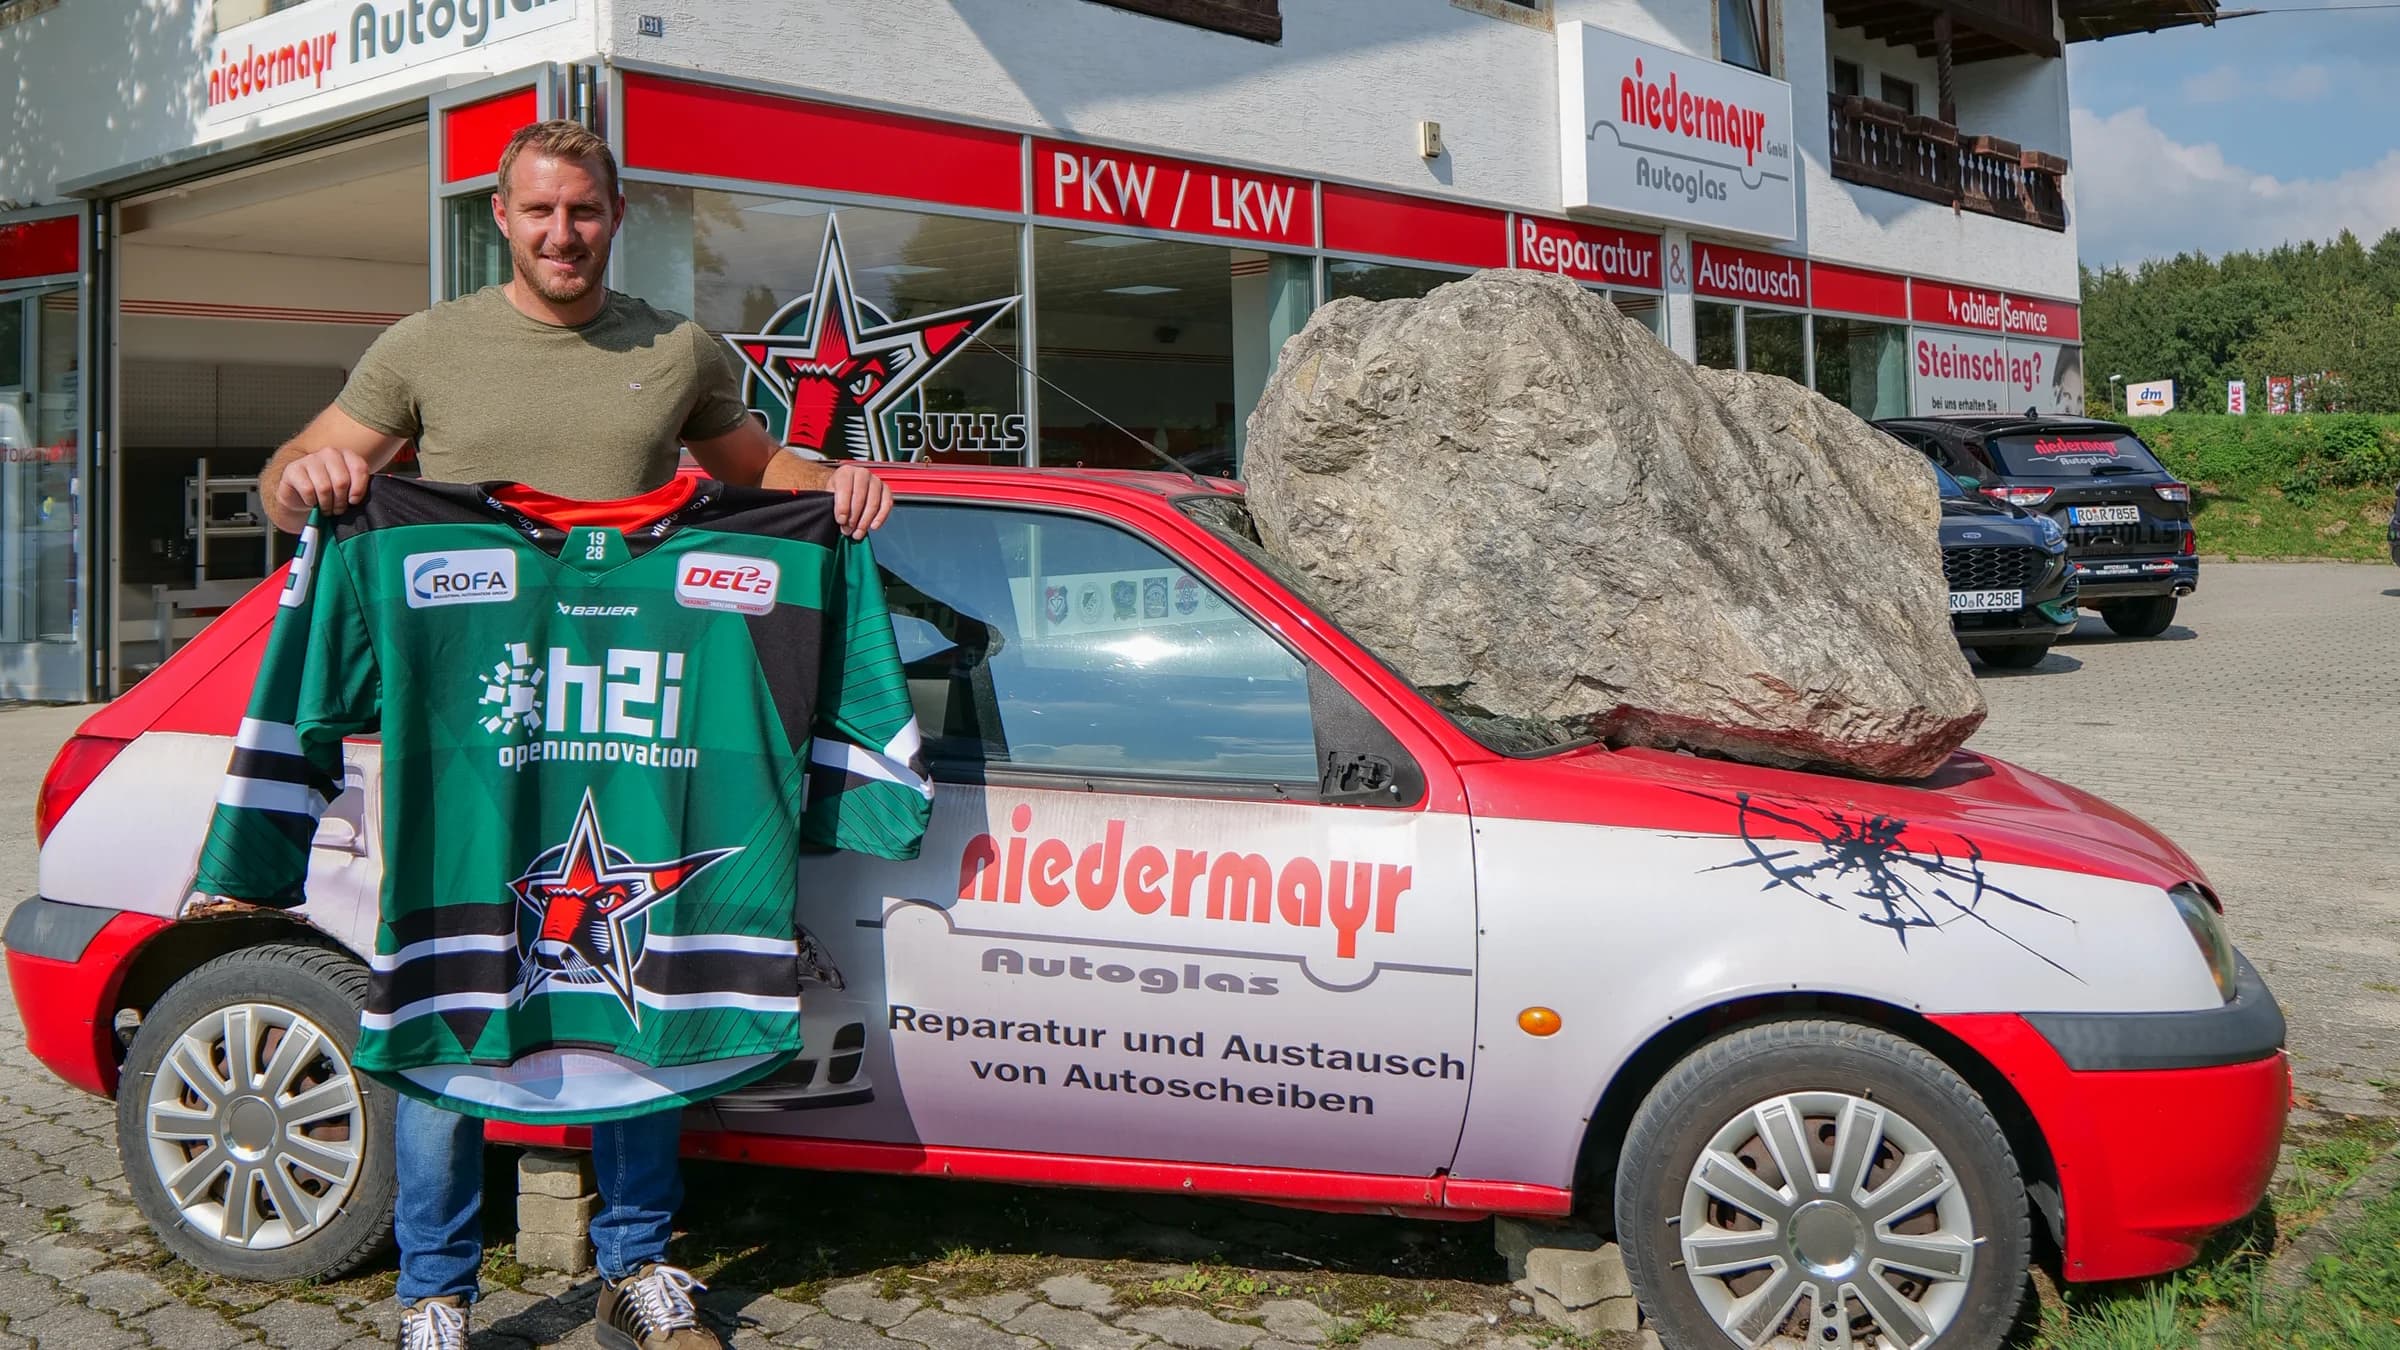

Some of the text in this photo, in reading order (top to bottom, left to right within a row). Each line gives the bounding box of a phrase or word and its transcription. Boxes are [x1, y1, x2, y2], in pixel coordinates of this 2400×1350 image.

[208, 0, 560, 106] niedermayr Autog
[1621, 57, 1788, 167] niedermayr GmbH
[1054, 152, 1156, 219] PKW
[1211, 175, 1295, 236] LKW
[1636, 156, 1727, 204] Autoglas
[1521, 218, 1800, 298] Reparatur & Austausch
[2004, 298, 2048, 333] Service
[1932, 396, 1997, 411] bei uns erhalten Sie
[2141, 387, 2162, 400] dm
[895, 412, 1028, 451] BULLS
[2034, 436, 2117, 456] niedermayr
[2060, 457, 2112, 465] Autoglas
[2078, 509, 2093, 520] RO
[586, 546, 604, 560] 28
[588, 532, 605, 546] 19
[432, 571, 507, 592] ROFA
[571, 605, 640, 617] BAUER
[1949, 594, 1968, 609] RO
[545, 647, 685, 739] h2i
[498, 738, 699, 772] openinnovation
[958, 803, 1412, 959] niedermayr
[982, 948, 1280, 995] Autoglas
[888, 1004, 1466, 1081] Reparatur und Austausch
[969, 1058, 1375, 1116] von Autoscheiben
